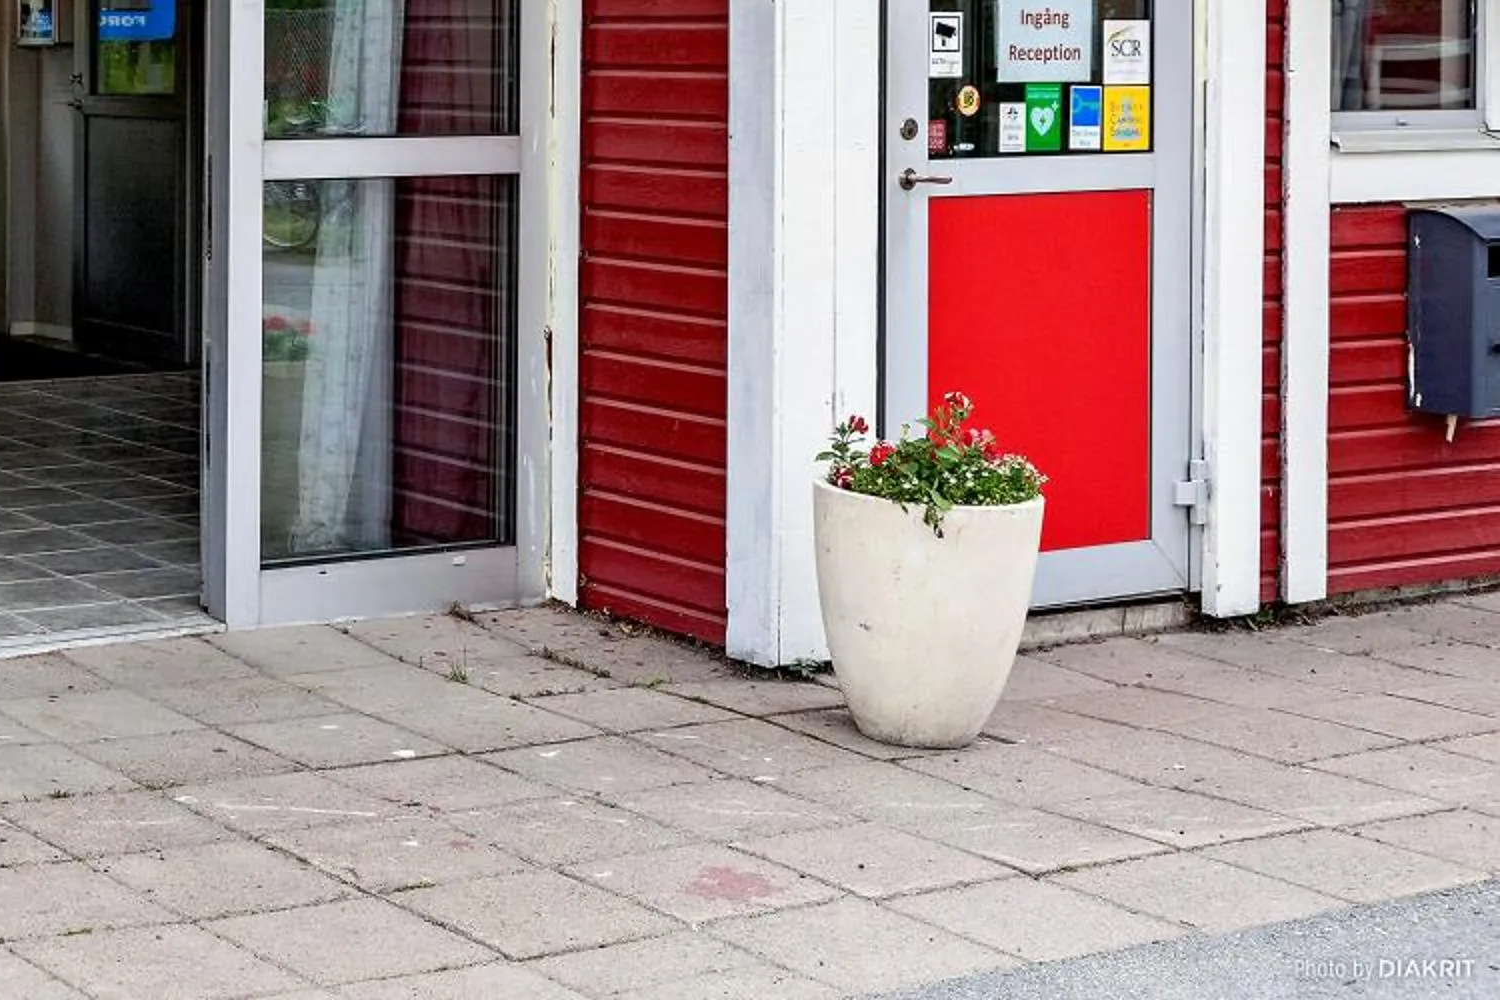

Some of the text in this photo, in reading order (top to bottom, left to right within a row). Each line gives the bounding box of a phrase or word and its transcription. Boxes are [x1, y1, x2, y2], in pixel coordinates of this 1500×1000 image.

[1020, 8, 1070, 29] Ingång
[1009, 43, 1081, 64] Reception
[1111, 39, 1142, 57] SCR
